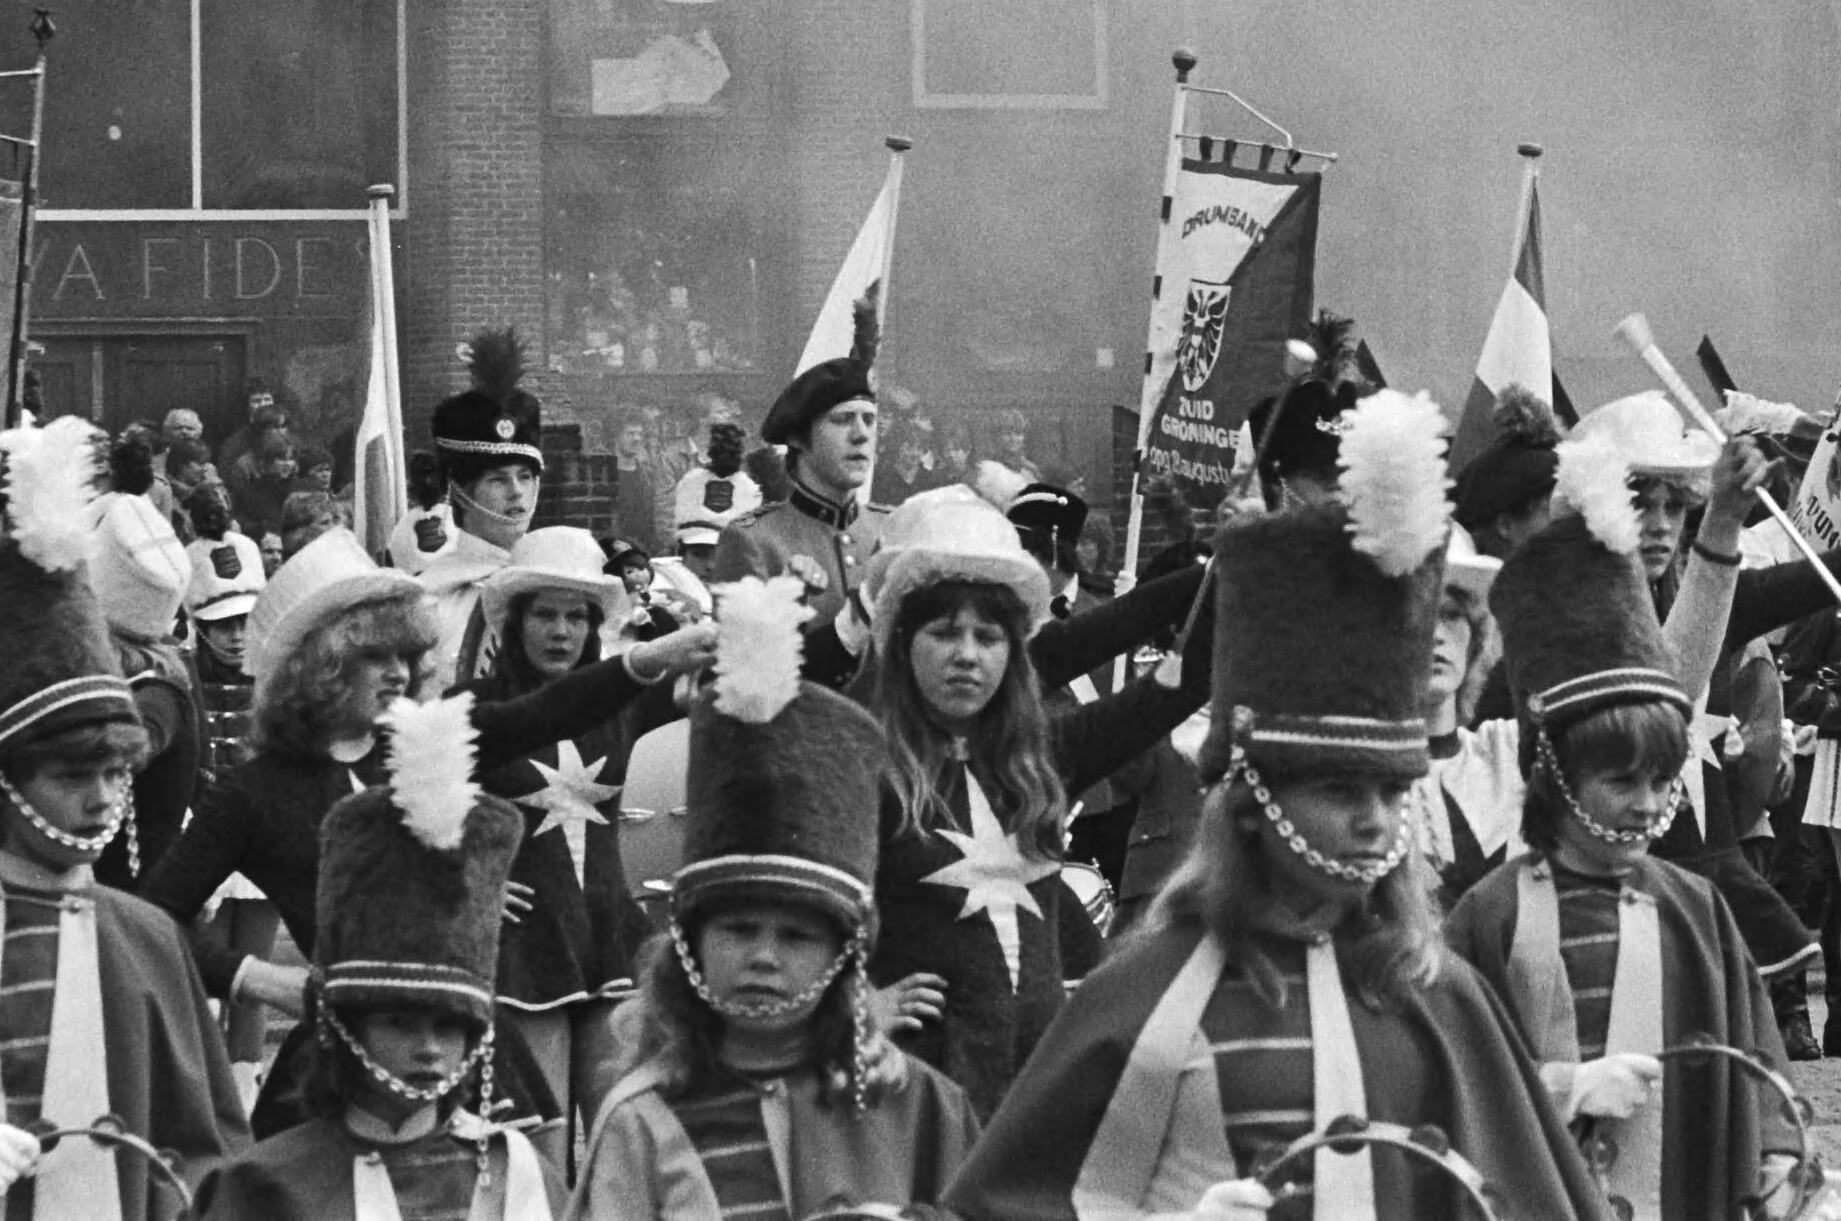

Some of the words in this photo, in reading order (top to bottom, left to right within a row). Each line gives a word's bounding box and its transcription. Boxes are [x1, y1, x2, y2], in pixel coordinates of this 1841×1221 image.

[1182, 205, 1264, 245] DRUMBAND
[143, 236, 367, 300] FIDE
[1179, 396, 1214, 420] ZUID
[1161, 413, 1242, 450] GRONINGE
